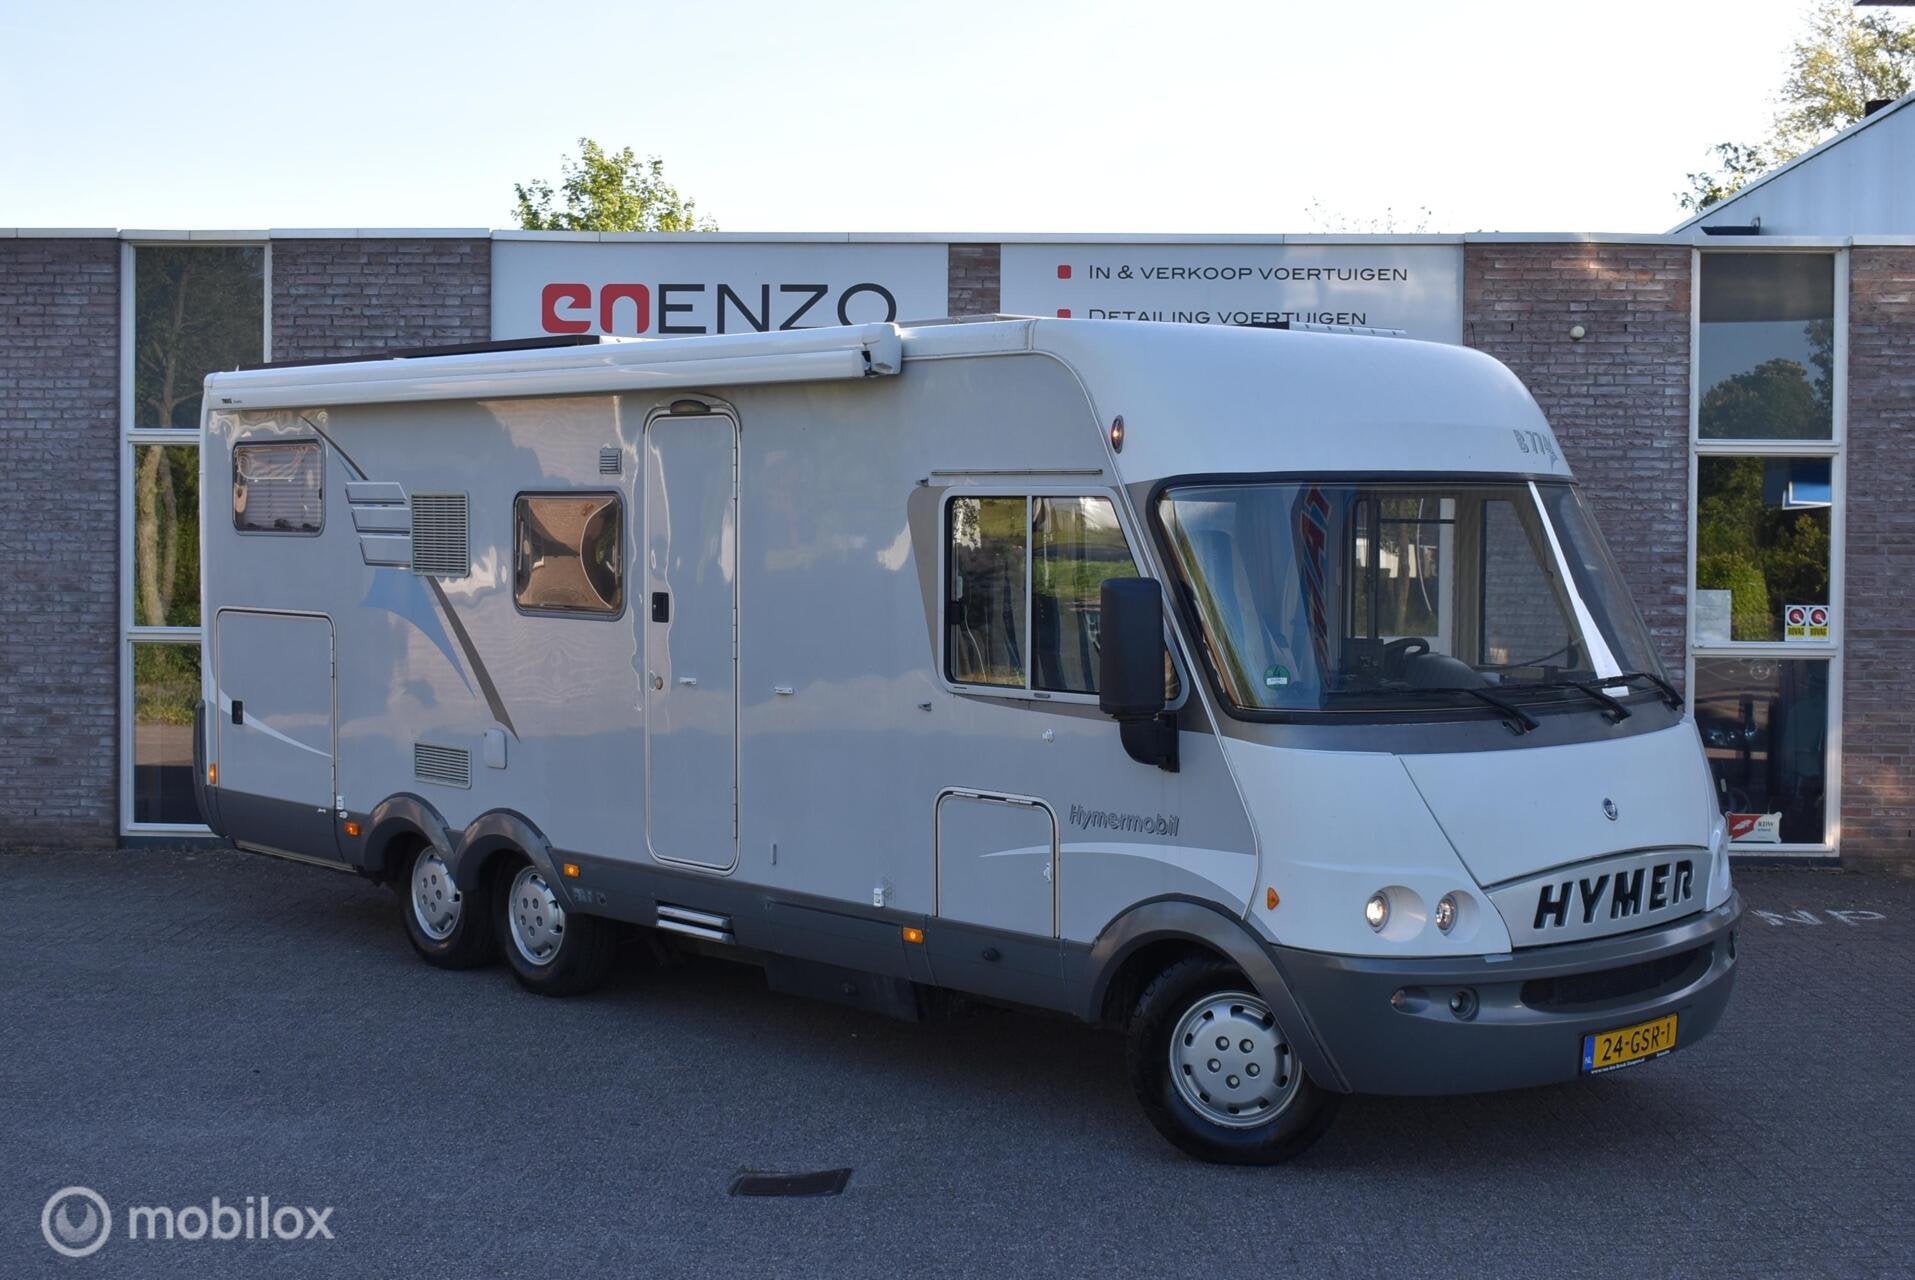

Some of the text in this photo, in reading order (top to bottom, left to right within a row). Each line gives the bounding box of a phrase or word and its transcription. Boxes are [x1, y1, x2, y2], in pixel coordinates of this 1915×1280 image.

[1088, 264, 1408, 281] IN & VERKOOP VOERTUIGEN
[657, 282, 898, 335] ENZO
[1217, 311, 1367, 325] VOERTUIGEN
[1069, 803, 1180, 837] Hymermobil
[1533, 859, 1695, 930] HYMER
[1601, 1022, 1671, 1062] 24-GSR-1
